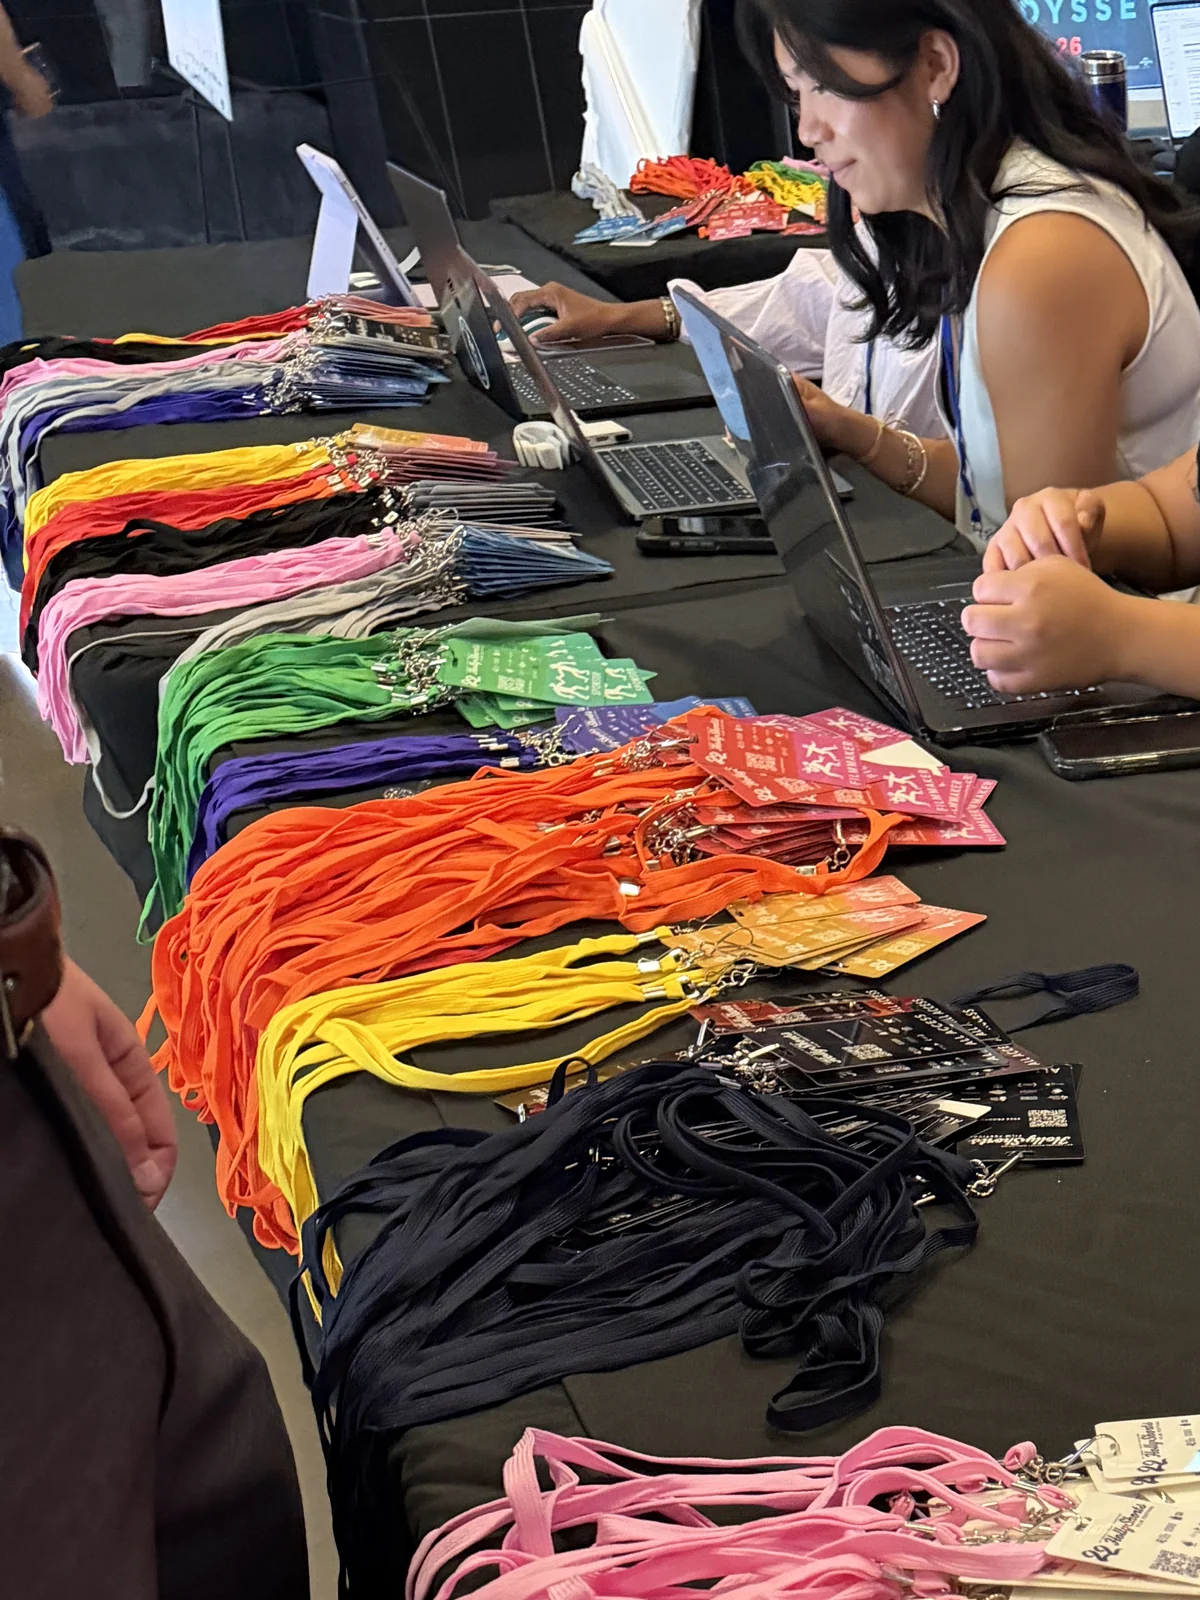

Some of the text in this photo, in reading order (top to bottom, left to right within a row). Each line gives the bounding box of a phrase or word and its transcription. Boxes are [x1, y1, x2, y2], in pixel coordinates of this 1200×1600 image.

[842, 741, 861, 786] FILMMAKER
[914, 1014, 957, 1034] ACCESS
[954, 1034, 978, 1046] ALL
[1137, 1458, 1168, 1473] 22
[1081, 1545, 1122, 1562] 22
